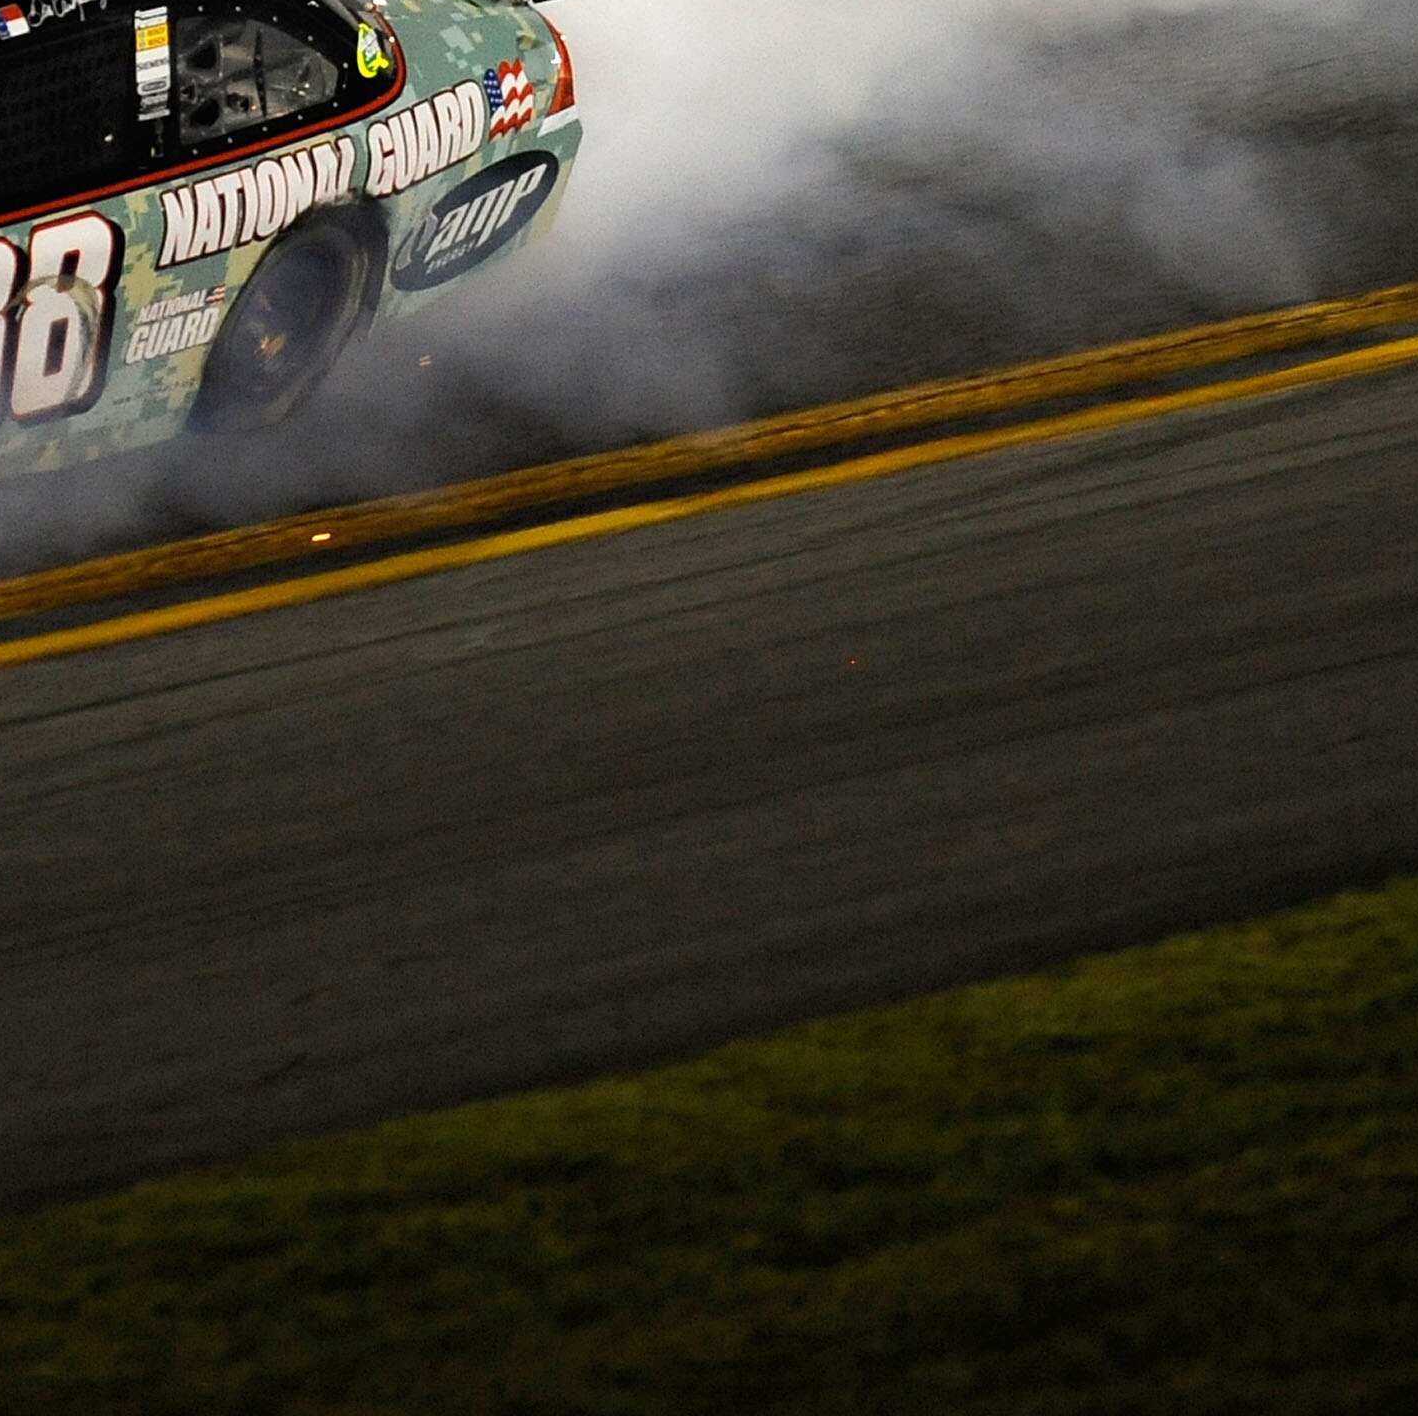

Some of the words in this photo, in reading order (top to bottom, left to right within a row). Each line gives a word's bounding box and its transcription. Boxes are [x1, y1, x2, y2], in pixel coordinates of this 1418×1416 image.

[156, 136, 357, 271] NATIONAL
[366, 79, 486, 198] GUARD
[134, 288, 208, 325] NATIONAL
[125, 307, 220, 366] GUARD
